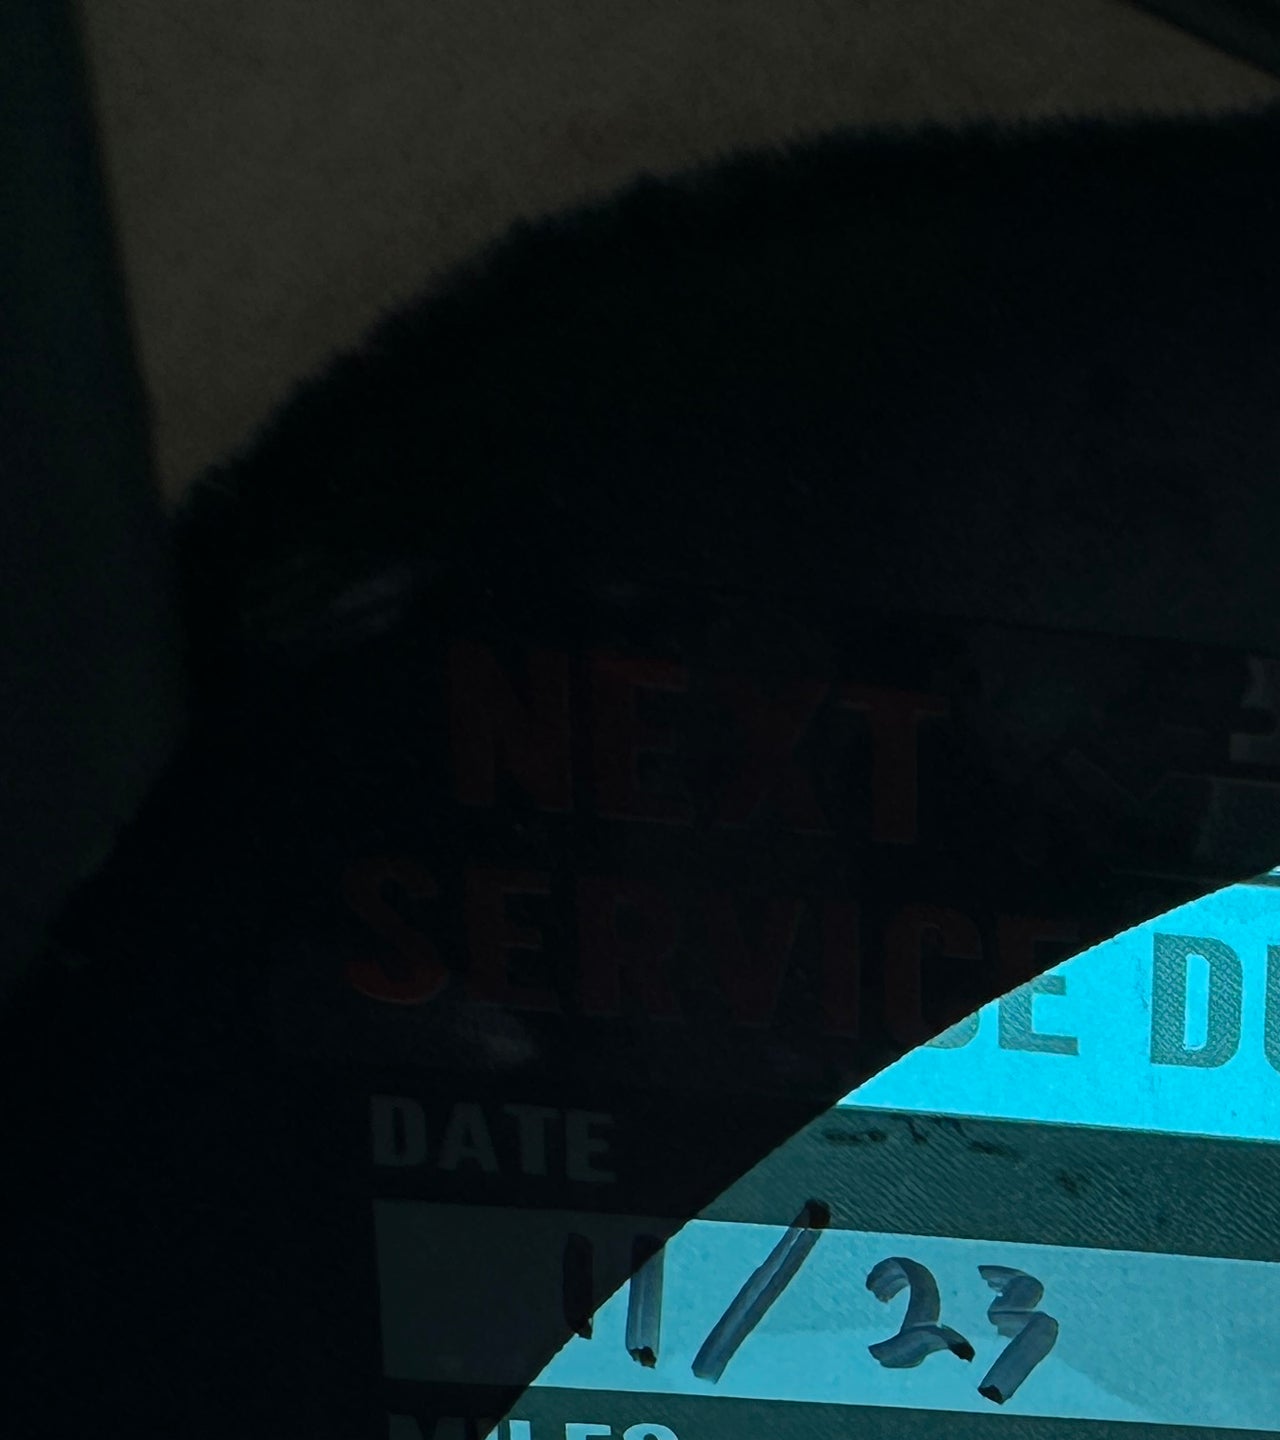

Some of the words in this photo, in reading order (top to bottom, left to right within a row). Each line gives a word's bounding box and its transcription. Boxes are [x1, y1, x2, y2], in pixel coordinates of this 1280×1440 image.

[443, 639, 948, 845] NEXT
[343, 855, 1081, 1056] SERVICE
[371, 1094, 616, 1183] DATE
